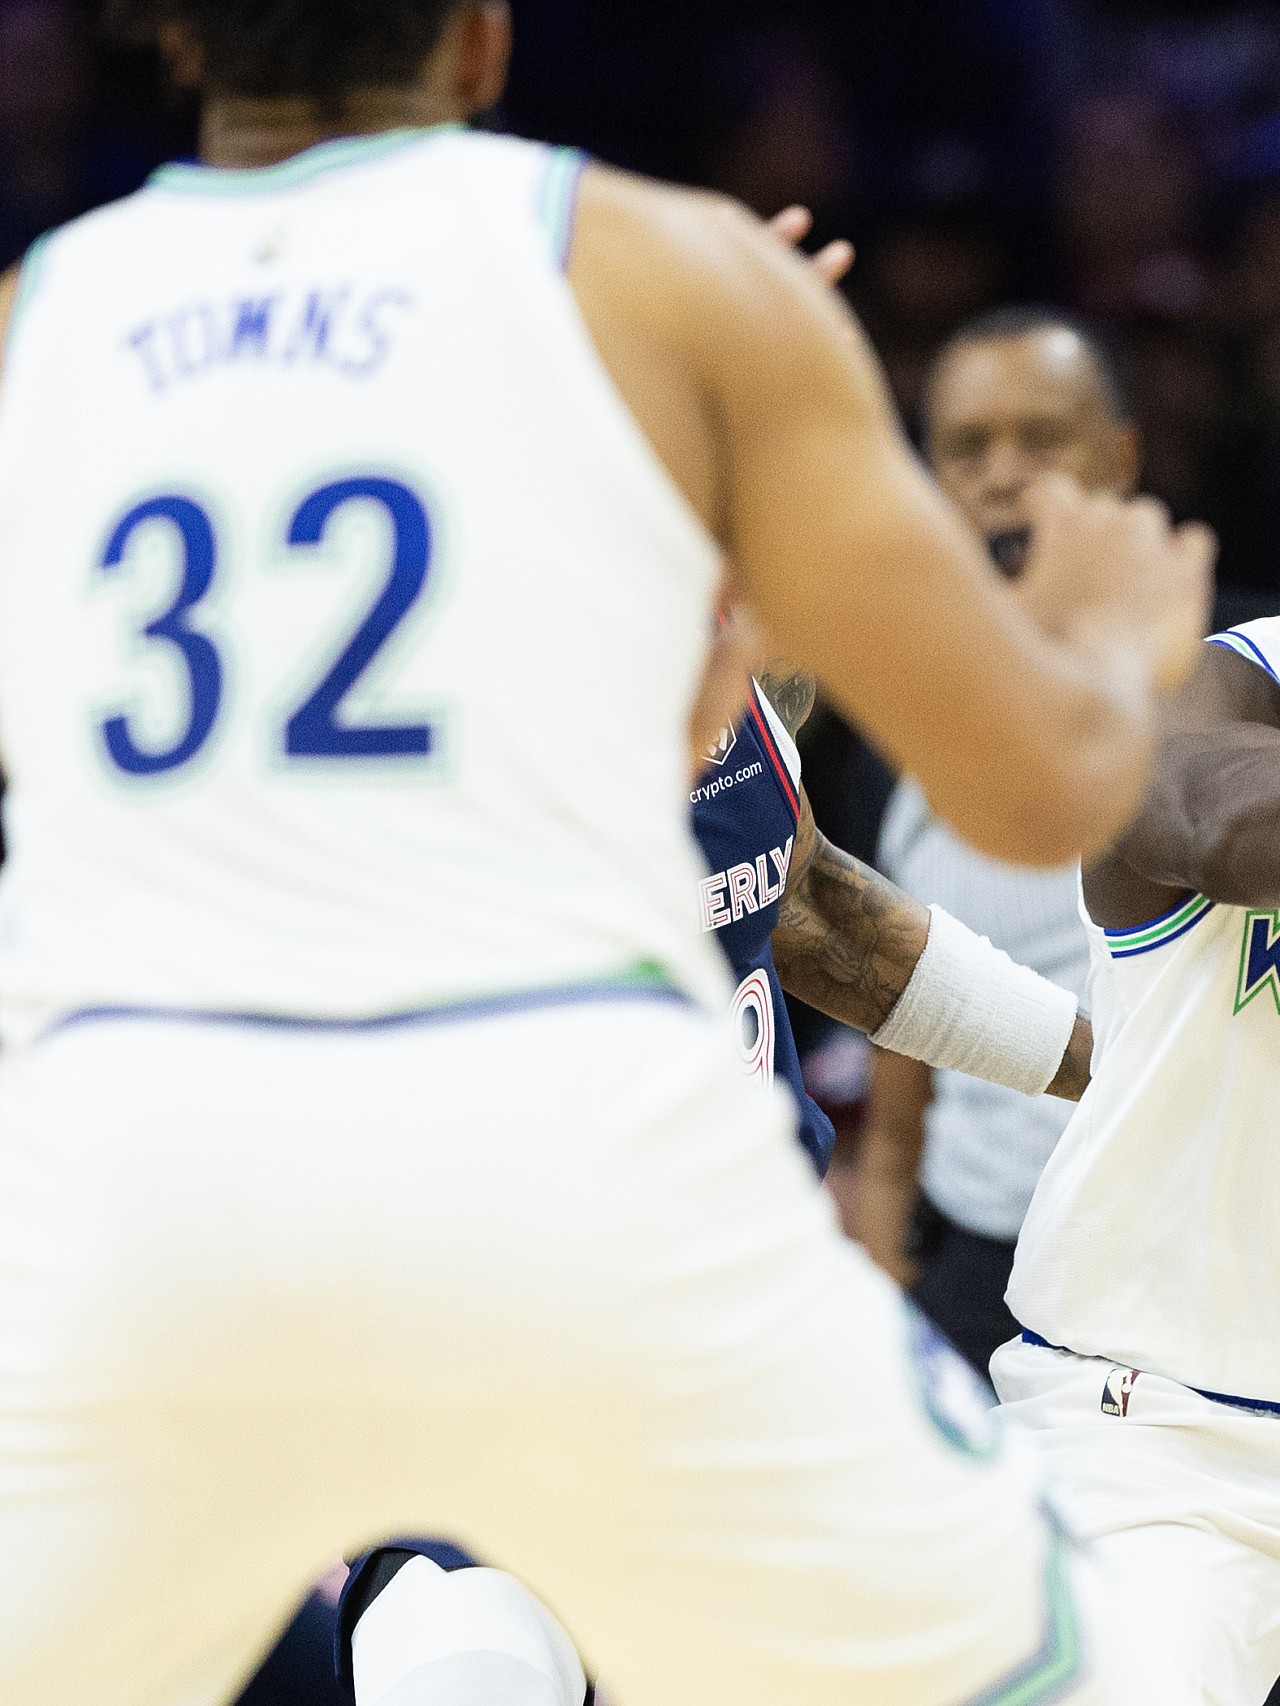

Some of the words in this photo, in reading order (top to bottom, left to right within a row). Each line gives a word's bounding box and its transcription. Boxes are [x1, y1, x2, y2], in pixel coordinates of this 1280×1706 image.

[118, 284, 415, 393] TOWNS
[93, 470, 442, 782] 32
[689, 762, 763, 804] crypto.com
[1102, 1402, 1120, 1416] NBA
